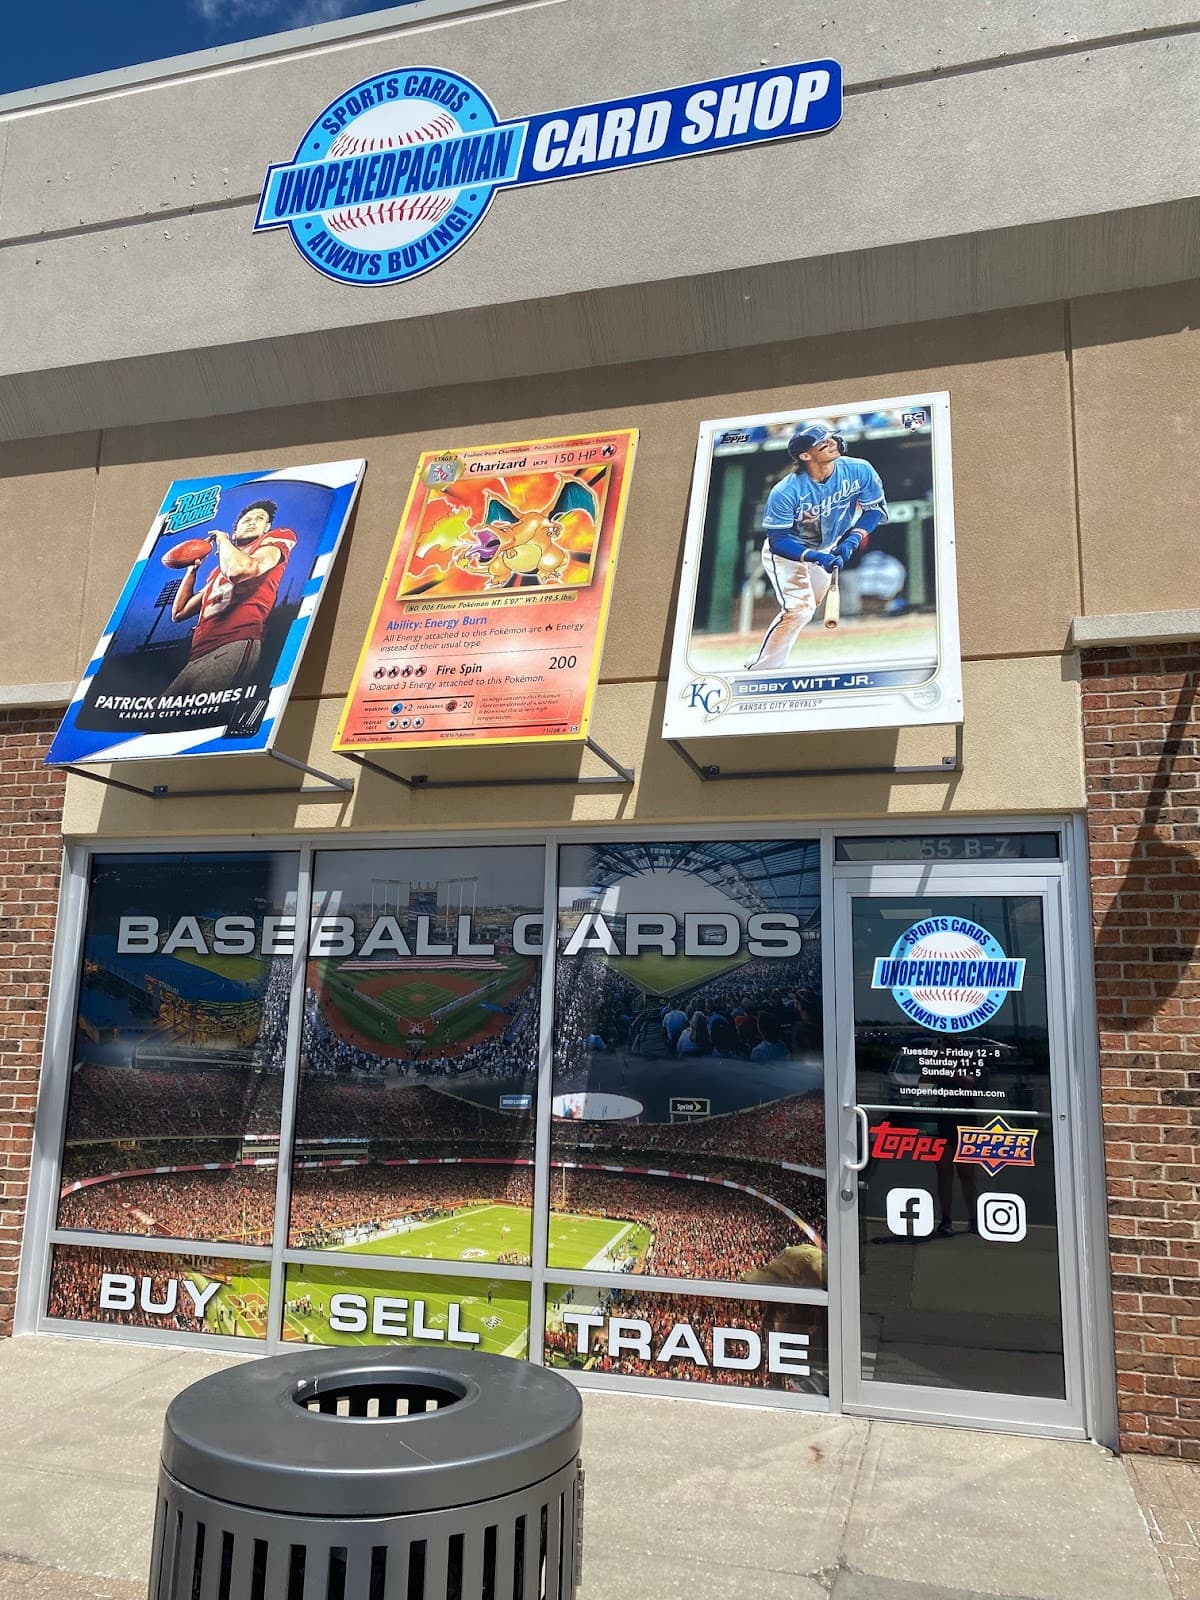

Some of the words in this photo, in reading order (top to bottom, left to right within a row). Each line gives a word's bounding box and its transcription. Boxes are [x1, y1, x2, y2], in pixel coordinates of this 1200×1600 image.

[322, 77, 399, 135] SPORTS
[403, 75, 471, 113] CARDS
[531, 99, 673, 172] CARD
[679, 69, 831, 145] SHOP
[273, 127, 515, 217] UNOPENEDPACKMAN
[306, 229, 382, 278] ALWAYS
[386, 205, 477, 275] BUYING!
[903, 412, 925, 422] RC
[469, 457, 527, 473] Charizard
[554, 452, 575, 464] 150
[578, 450, 597, 461] HP
[178, 486, 220, 513] RATED
[795, 479, 861, 521] Royals
[167, 501, 217, 532] ROOKIE
[436, 603, 456, 611] Flame
[458, 600, 490, 609] Pokémon
[383, 634, 395, 643] All
[396, 633, 423, 643] Energy
[424, 630, 459, 640] attached
[461, 630, 470, 638] to
[472, 629, 488, 637] this
[489, 626, 527, 636] Pokémon
[556, 623, 585, 632] Energy
[386, 620, 423, 632] Ability:
[424, 618, 459, 630] Energy
[462, 615, 488, 626] Burn
[380, 643, 408, 652] instead
[409, 643, 420, 651] of
[420, 641, 440, 650] their
[441, 640, 461, 649] usual
[436, 664, 456, 676] Fire
[459, 663, 482, 677] Spin
[548, 655, 577, 670] 200
[368, 681, 400, 691] Discard
[401, 681, 407, 690] 3
[408, 680, 437, 690] Energy
[438, 679, 473, 688] attached
[475, 678, 485, 686] to
[487, 676, 502, 685] this
[504, 675, 545, 685] Pokémon.
[738, 682, 789, 693] BOBBY
[791, 676, 841, 690] WITT
[842, 674, 875, 688] JR.
[94, 695, 155, 711] PATRICK
[157, 687, 243, 711] MAHOMES
[244, 684, 258, 699] II
[687, 682, 722, 714] KC
[738, 702, 768, 712] KANSAS
[769, 701, 788, 711] CITY
[118, 711, 156, 719] KANSAS
[159, 710, 182, 719] CITY
[184, 705, 221, 717] CHIEFS
[920, 840, 950, 858] 55
[964, 838, 1011, 857] B-7
[116, 915, 495, 956] BASEBALL
[904, 918, 949, 945] SPORTS
[950, 918, 991, 946] CARDS
[879, 959, 1018, 987] UNOPENEDPACKMAN
[901, 998, 947, 1030] ALWAYS
[950, 999, 1000, 1030] BUYING!
[902, 1047, 938, 1058] Tuesday
[946, 1048, 974, 1058] Friday
[976, 1049, 987, 1057] 12
[994, 1049, 1000, 1058] 8
[918, 1057, 958, 1068] Saturday
[960, 1058, 970, 1067] 11
[978, 1059, 984, 1067] 6
[921, 1067, 956, 1078] Sunday
[957, 1068, 967, 1077] 11
[975, 1069, 982, 1077] 5
[900, 1087, 1006, 1098] unopenedpackman.com
[676, 1102, 694, 1113] Sprint
[961, 1133, 1031, 1147] UPPER
[99, 1273, 221, 1318] BUY
[329, 1293, 481, 1344] SELL
[562, 1311, 811, 1377] TRADE
